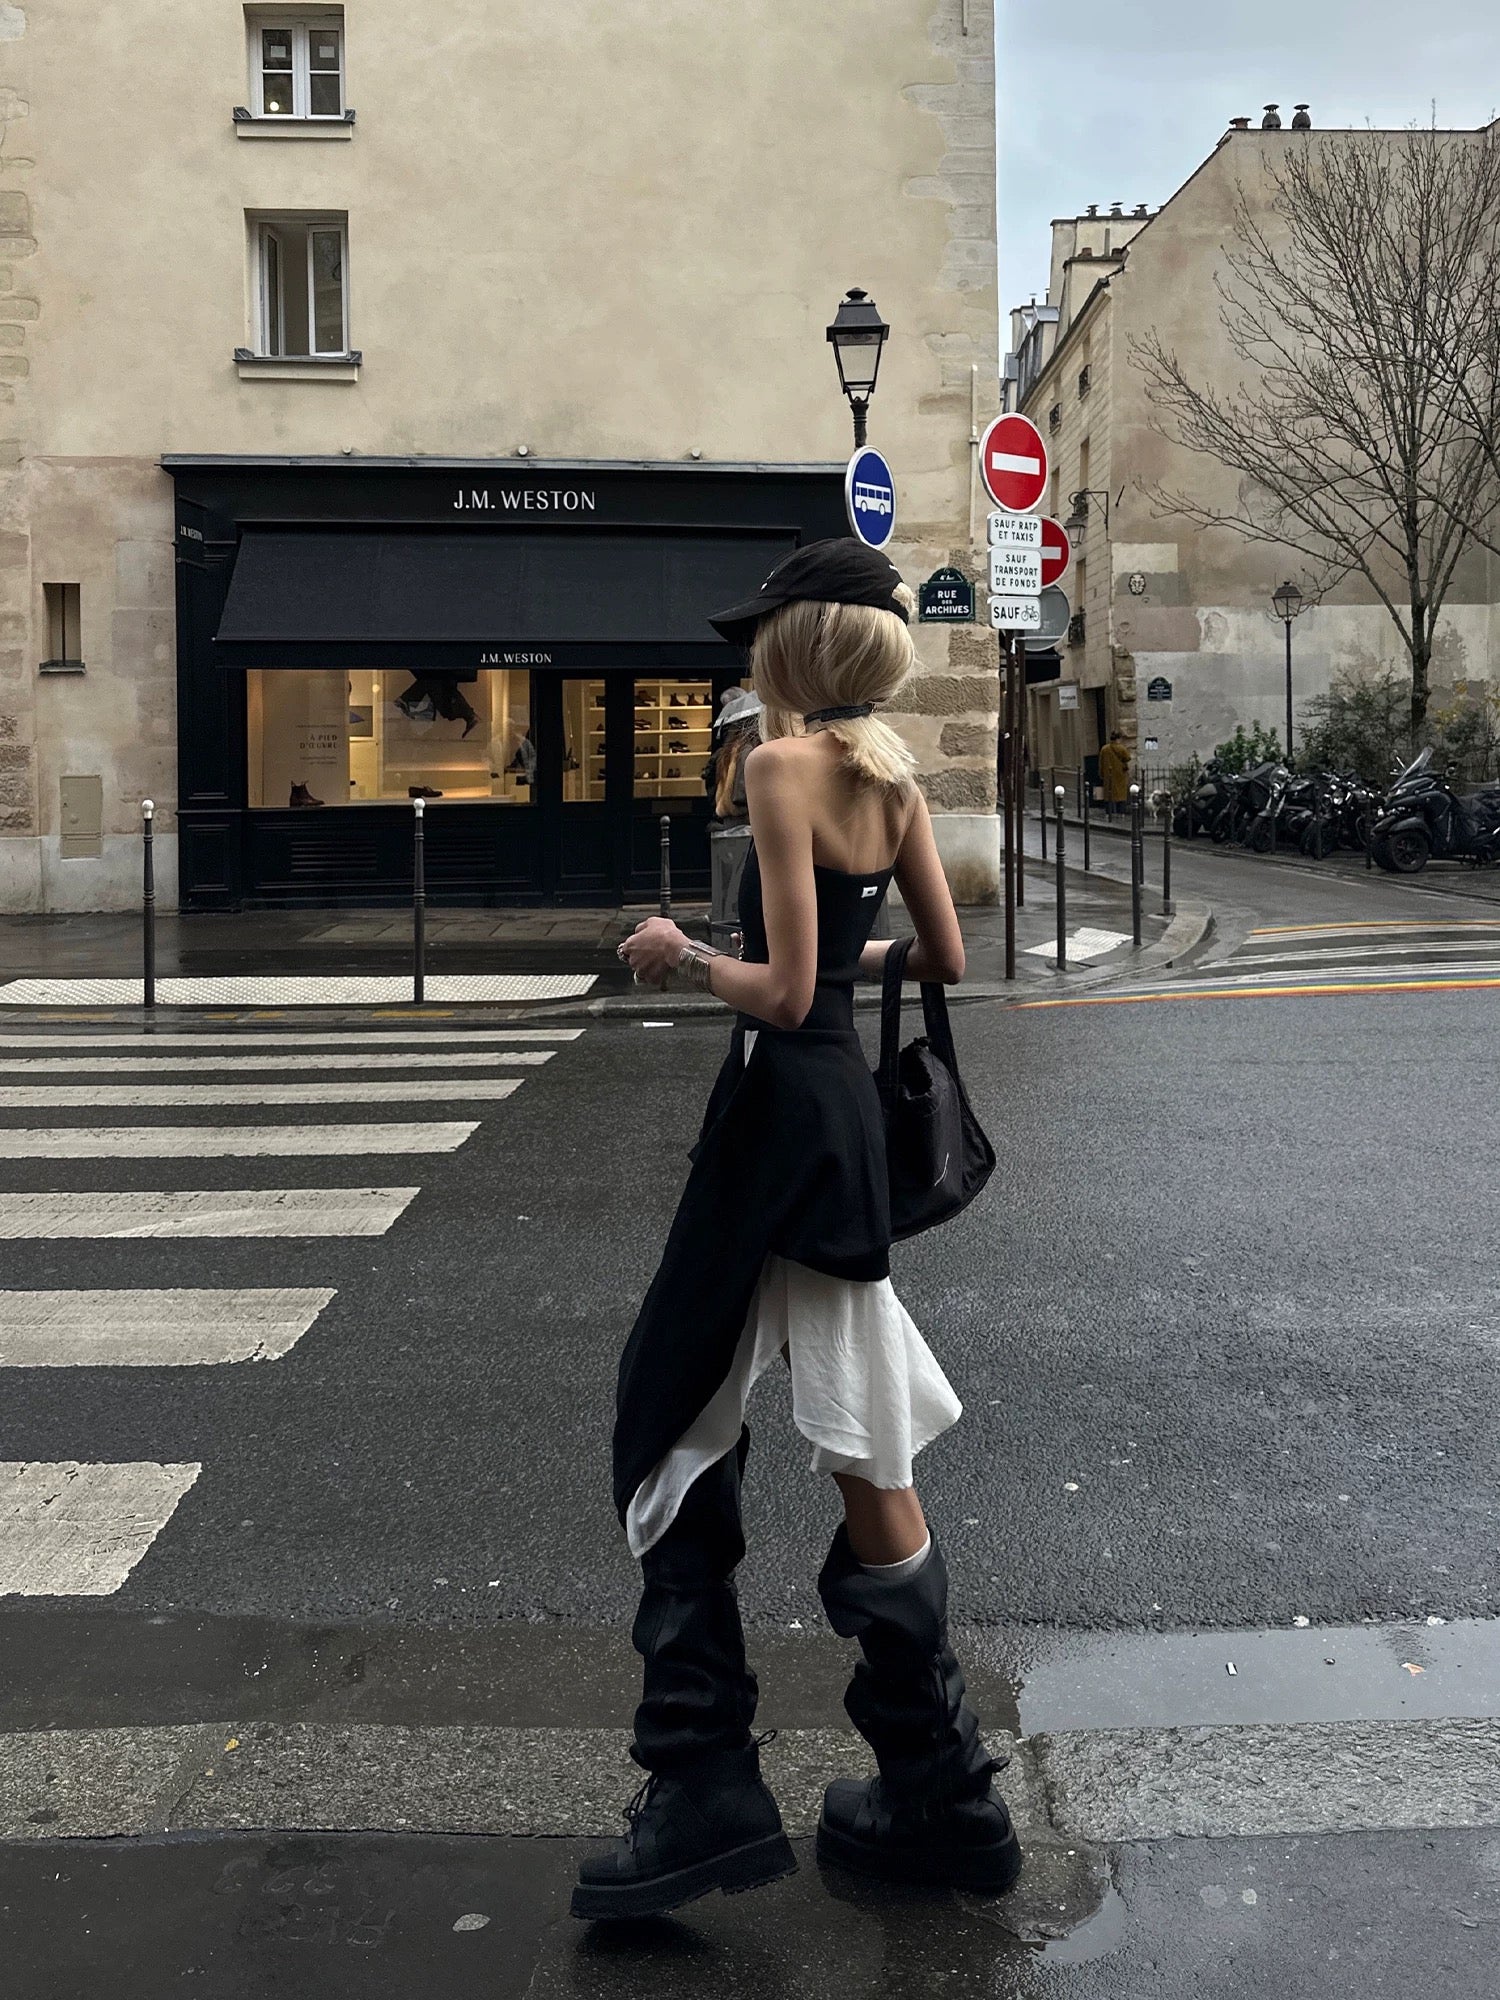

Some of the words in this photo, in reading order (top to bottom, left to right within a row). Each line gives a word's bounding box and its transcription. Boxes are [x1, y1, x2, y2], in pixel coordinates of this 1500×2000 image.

[453, 490, 496, 509] J.M.
[501, 490, 595, 510] WESTON
[994, 519, 1015, 528] SAUF
[1019, 521, 1038, 530] RATP
[998, 530, 1008, 539] ET
[1012, 531, 1034, 541] TAXIS
[1005, 554, 1027, 563] SAUF
[994, 565, 1038, 576] TRANSPORT
[995, 577, 1006, 586] DE
[1009, 578, 1036, 588] FONDS
[937, 590, 957, 598] RUE
[925, 605, 969, 614] ARCHIVES
[993, 606, 1020, 619] SAUF
[480, 653, 502, 663] J.M.
[503, 653, 552, 663] WESTON
